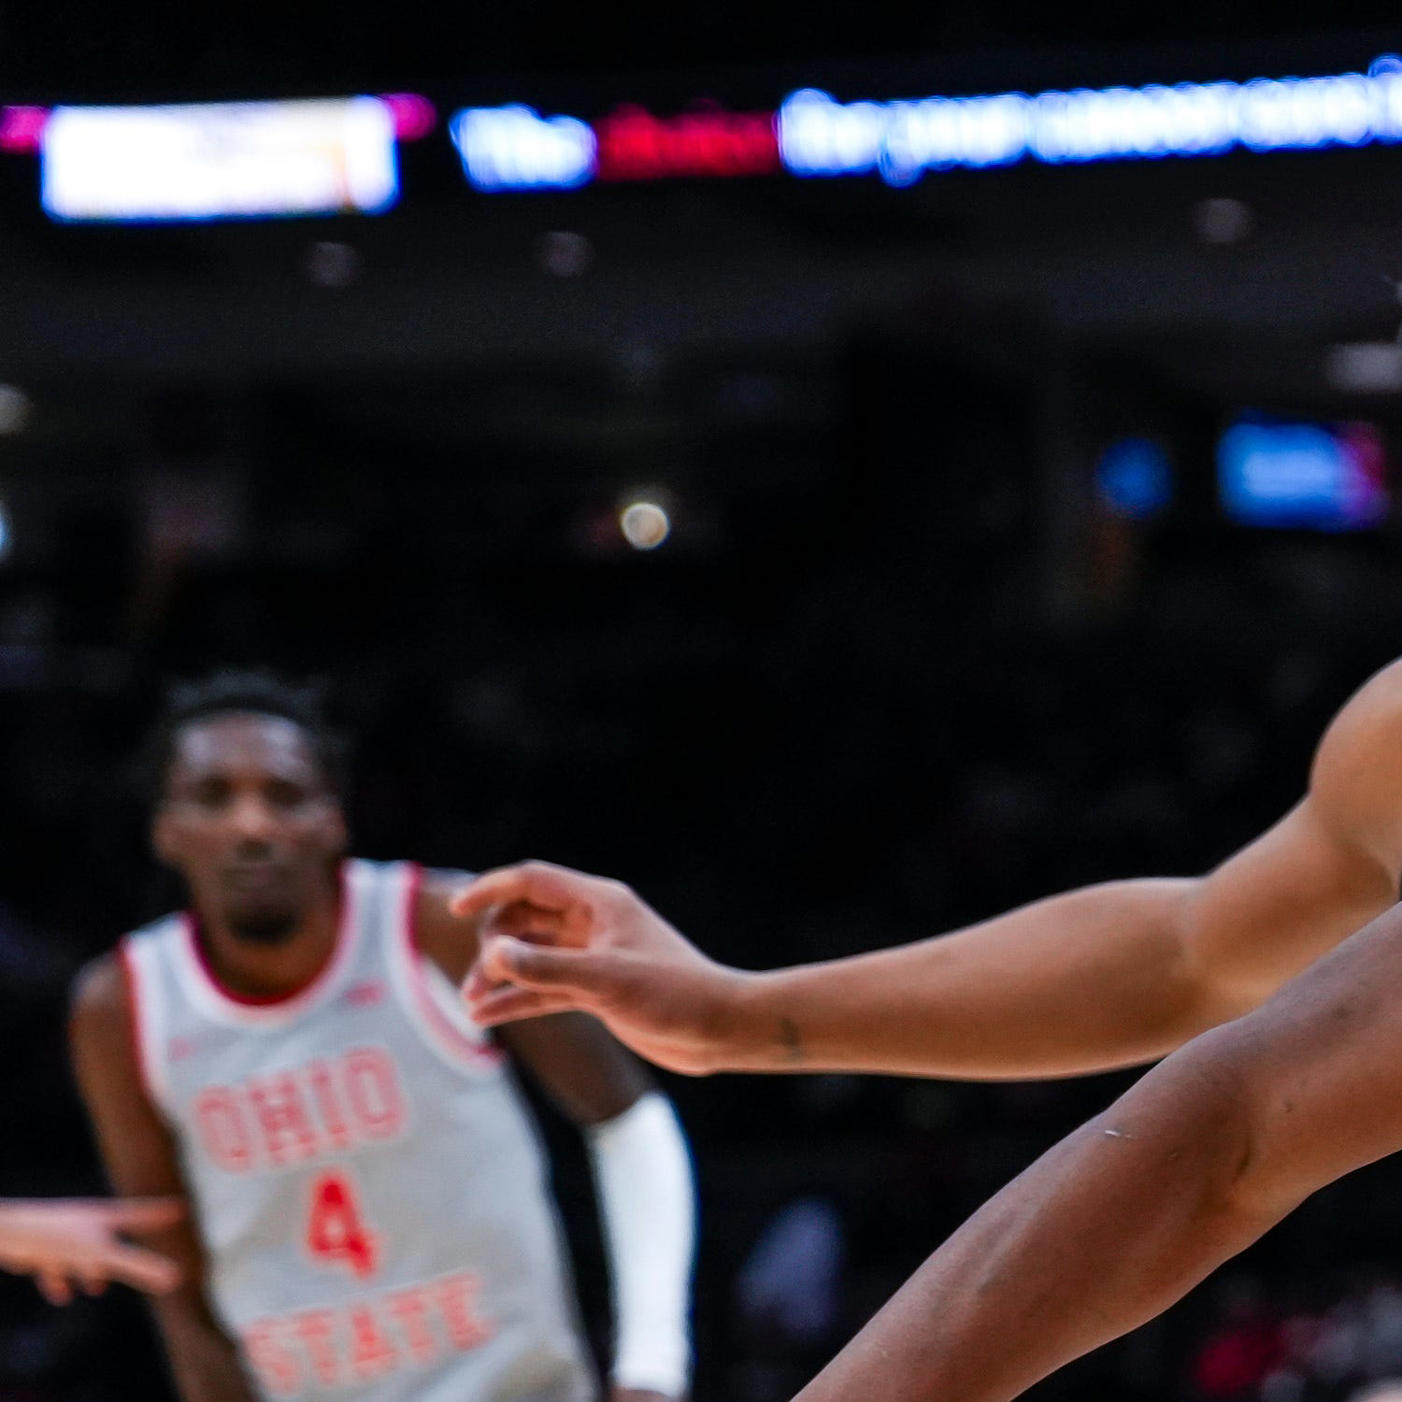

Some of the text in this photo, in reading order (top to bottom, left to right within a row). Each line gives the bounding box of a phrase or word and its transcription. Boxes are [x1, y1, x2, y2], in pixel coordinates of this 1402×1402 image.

[196, 1046, 404, 1173] OHIO
[306, 1171, 378, 1281] 4
[243, 1273, 493, 1391] STATE
